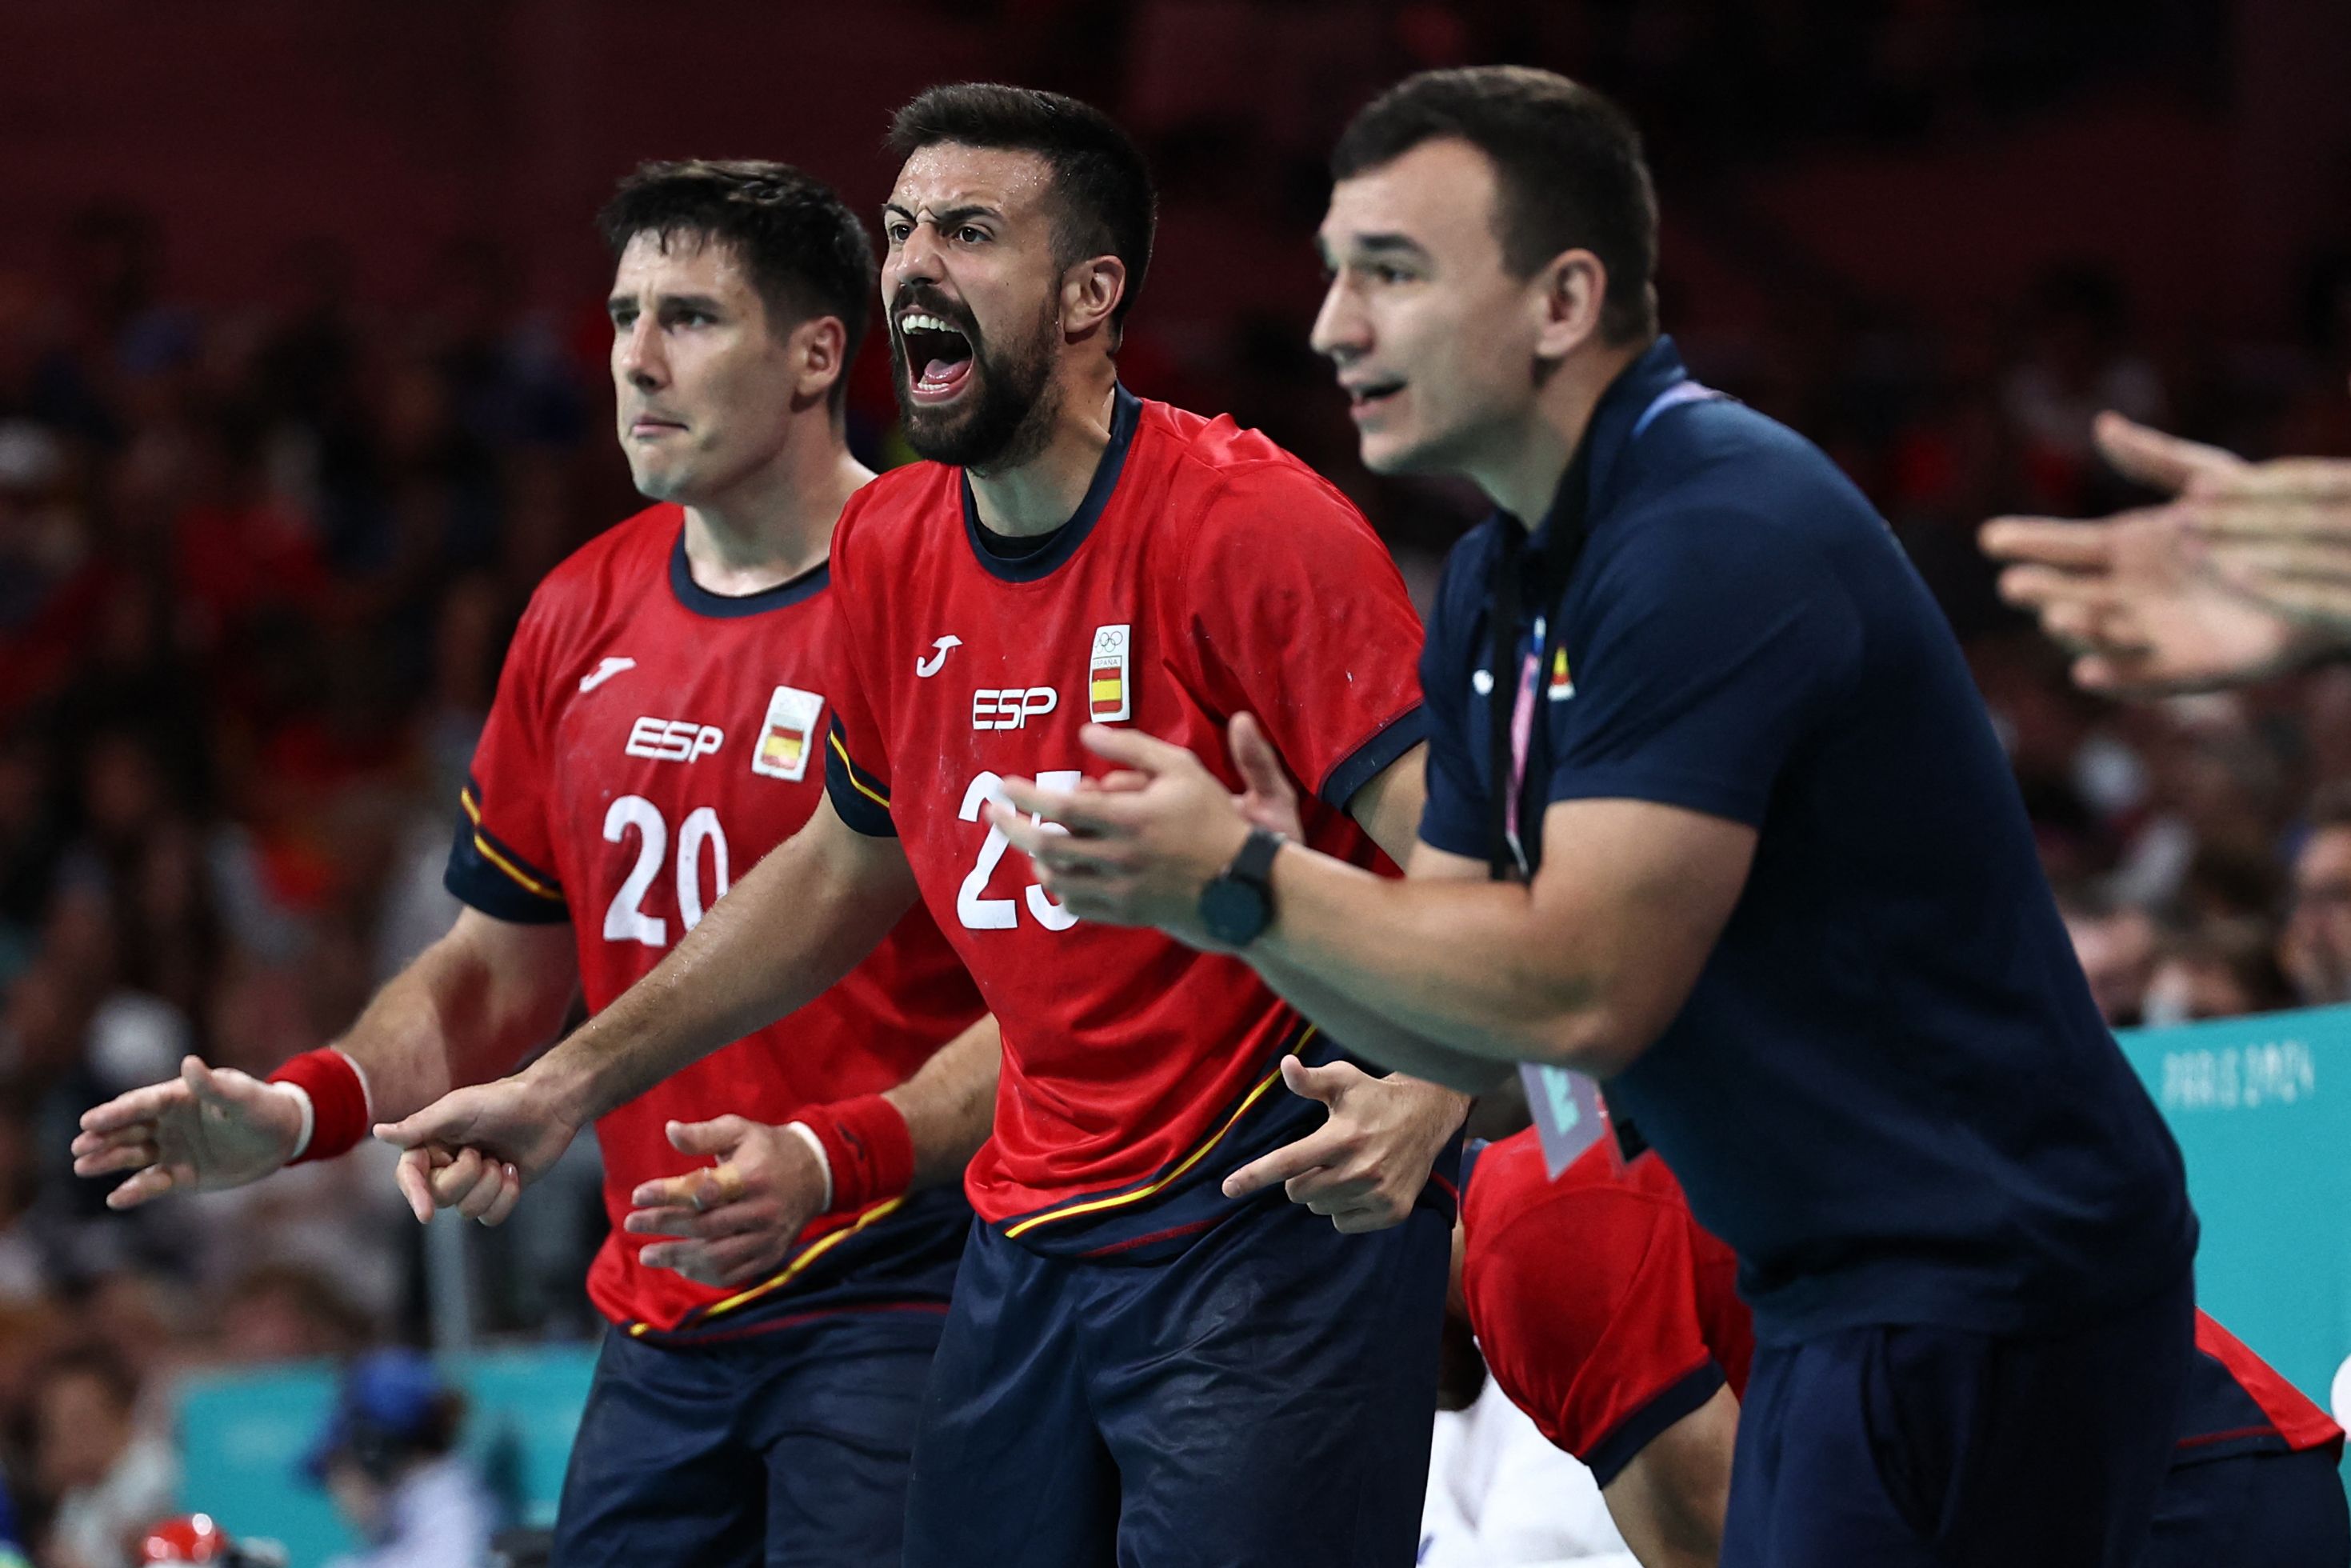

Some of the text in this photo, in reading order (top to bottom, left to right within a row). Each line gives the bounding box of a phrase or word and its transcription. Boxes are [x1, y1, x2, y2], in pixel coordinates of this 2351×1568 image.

[973, 686, 1058, 730] ESP
[625, 716, 725, 764] ESP
[603, 794, 730, 947] 20
